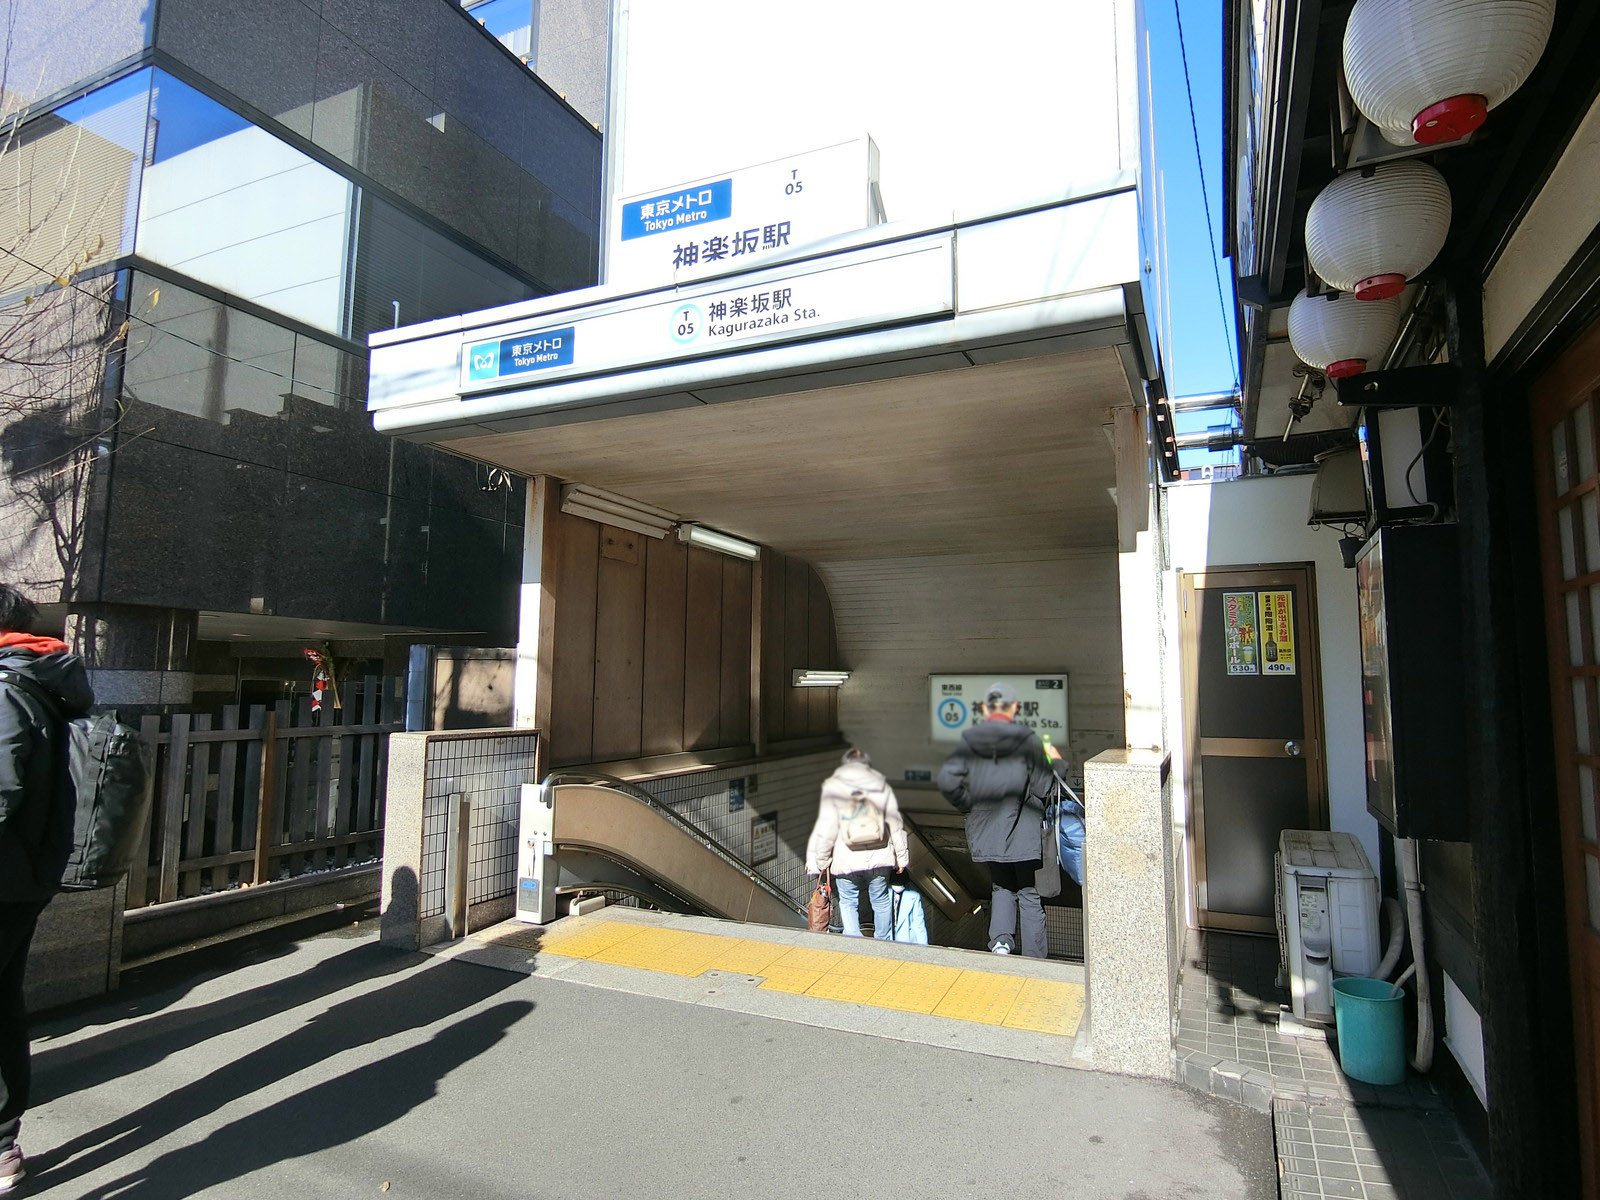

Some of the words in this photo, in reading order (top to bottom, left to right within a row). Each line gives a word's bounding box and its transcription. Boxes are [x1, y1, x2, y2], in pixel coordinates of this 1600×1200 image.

[791, 169, 798, 180] T
[785, 182, 803, 195] 05
[640, 189, 712, 221] 東京メトロ
[644, 215, 674, 232] Tokyo
[676, 209, 707, 227] Metro
[672, 221, 792, 270] 神楽坂駅
[708, 288, 792, 323] 神楽坂駅
[682, 311, 689, 321] T
[708, 311, 789, 337] Kagurazaka
[793, 307, 820, 323] Sta.
[677, 323, 694, 336] 05
[511, 337, 562, 358] 東京メトロ
[514, 355, 535, 368] Tokyo
[536, 351, 559, 364] Metro
[1277, 594, 1288, 642] 元気が出るお酒
[1227, 596, 1240, 664] スタミナハイボール
[1052, 680, 1059, 689] 2
[949, 703, 955, 711] T
[945, 712, 959, 722] 05
[1040, 718, 1063, 729] Sta.
